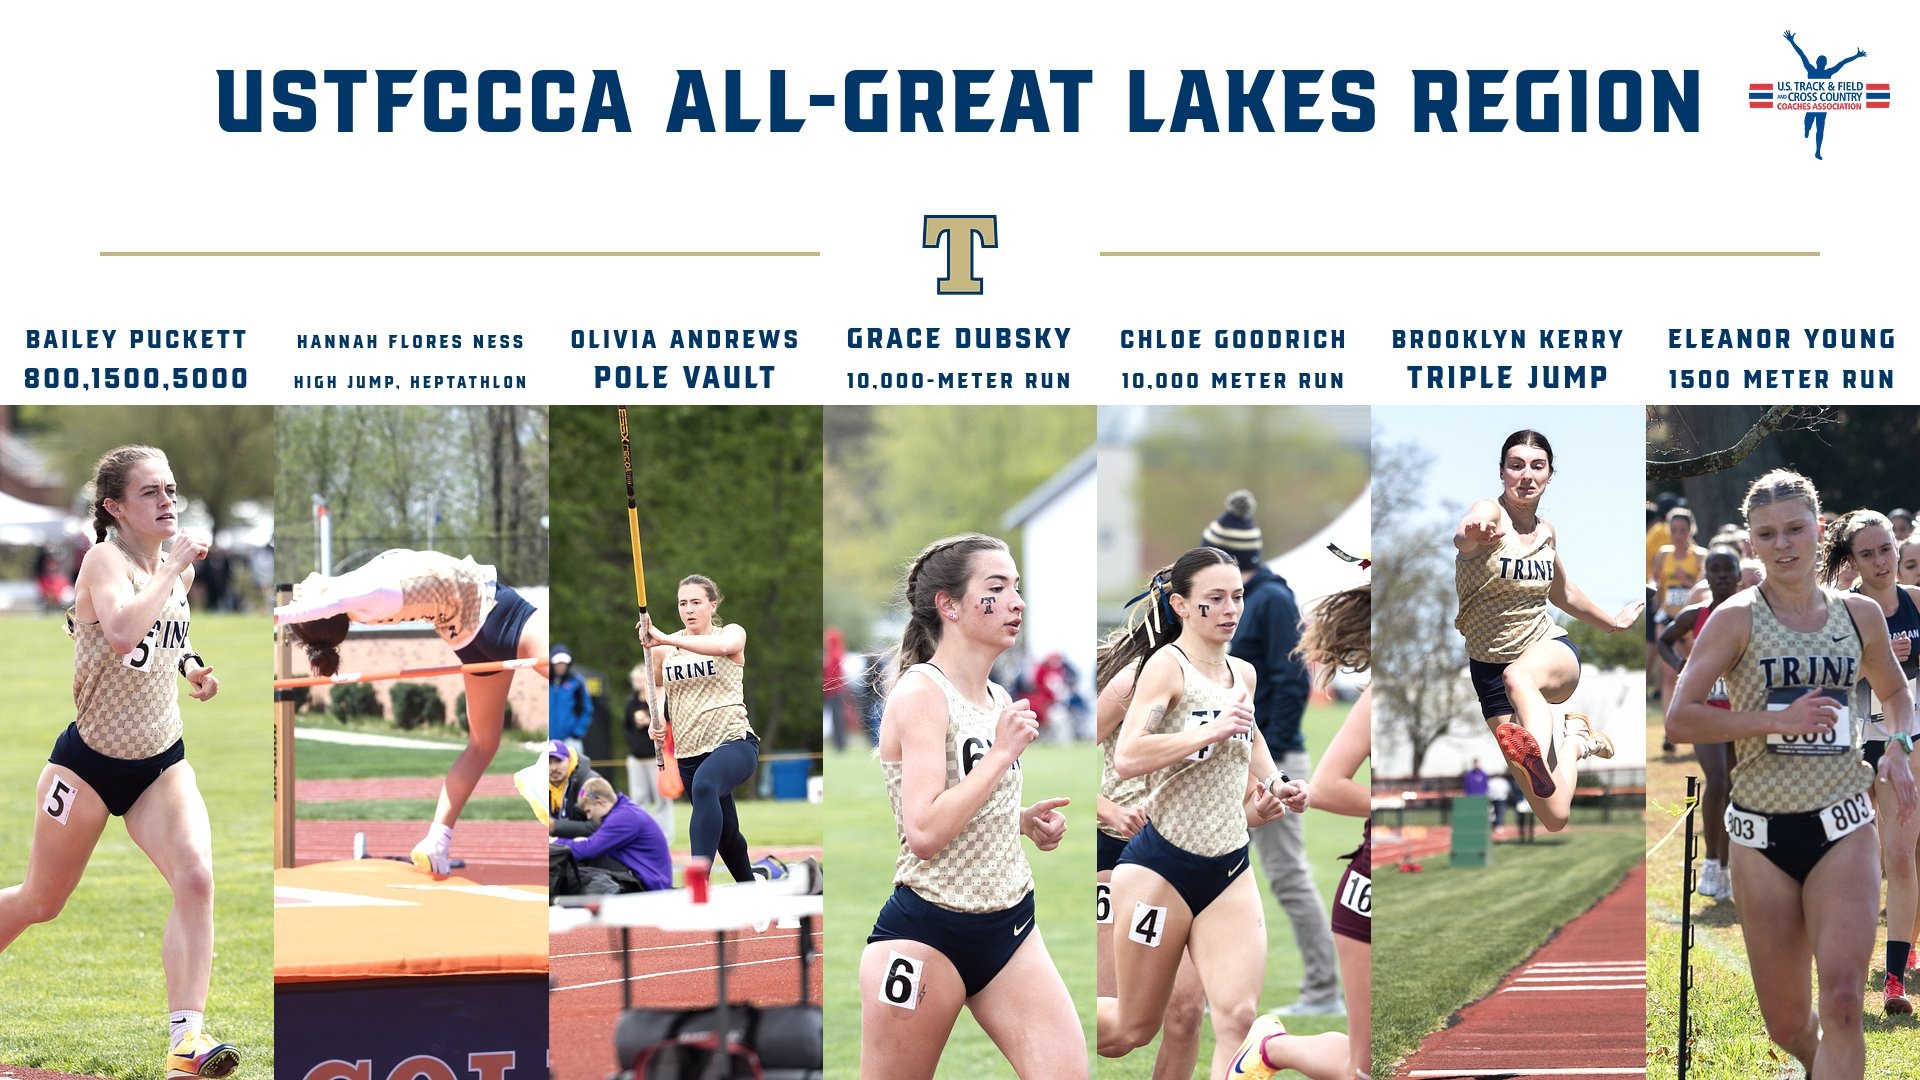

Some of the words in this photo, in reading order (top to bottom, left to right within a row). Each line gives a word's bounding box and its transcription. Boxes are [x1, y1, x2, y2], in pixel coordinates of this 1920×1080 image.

[1499, 556, 1553, 581] TRINE
[665, 660, 716, 681] TRINE
[1760, 656, 1855, 688] TRINE
[47, 781, 70, 817] 5
[1831, 793, 1870, 831] 803
[1097, 885, 1111, 921] 6
[1348, 876, 1371, 912] 16
[1135, 909, 1158, 943] 4
[885, 958, 914, 1004] 6
